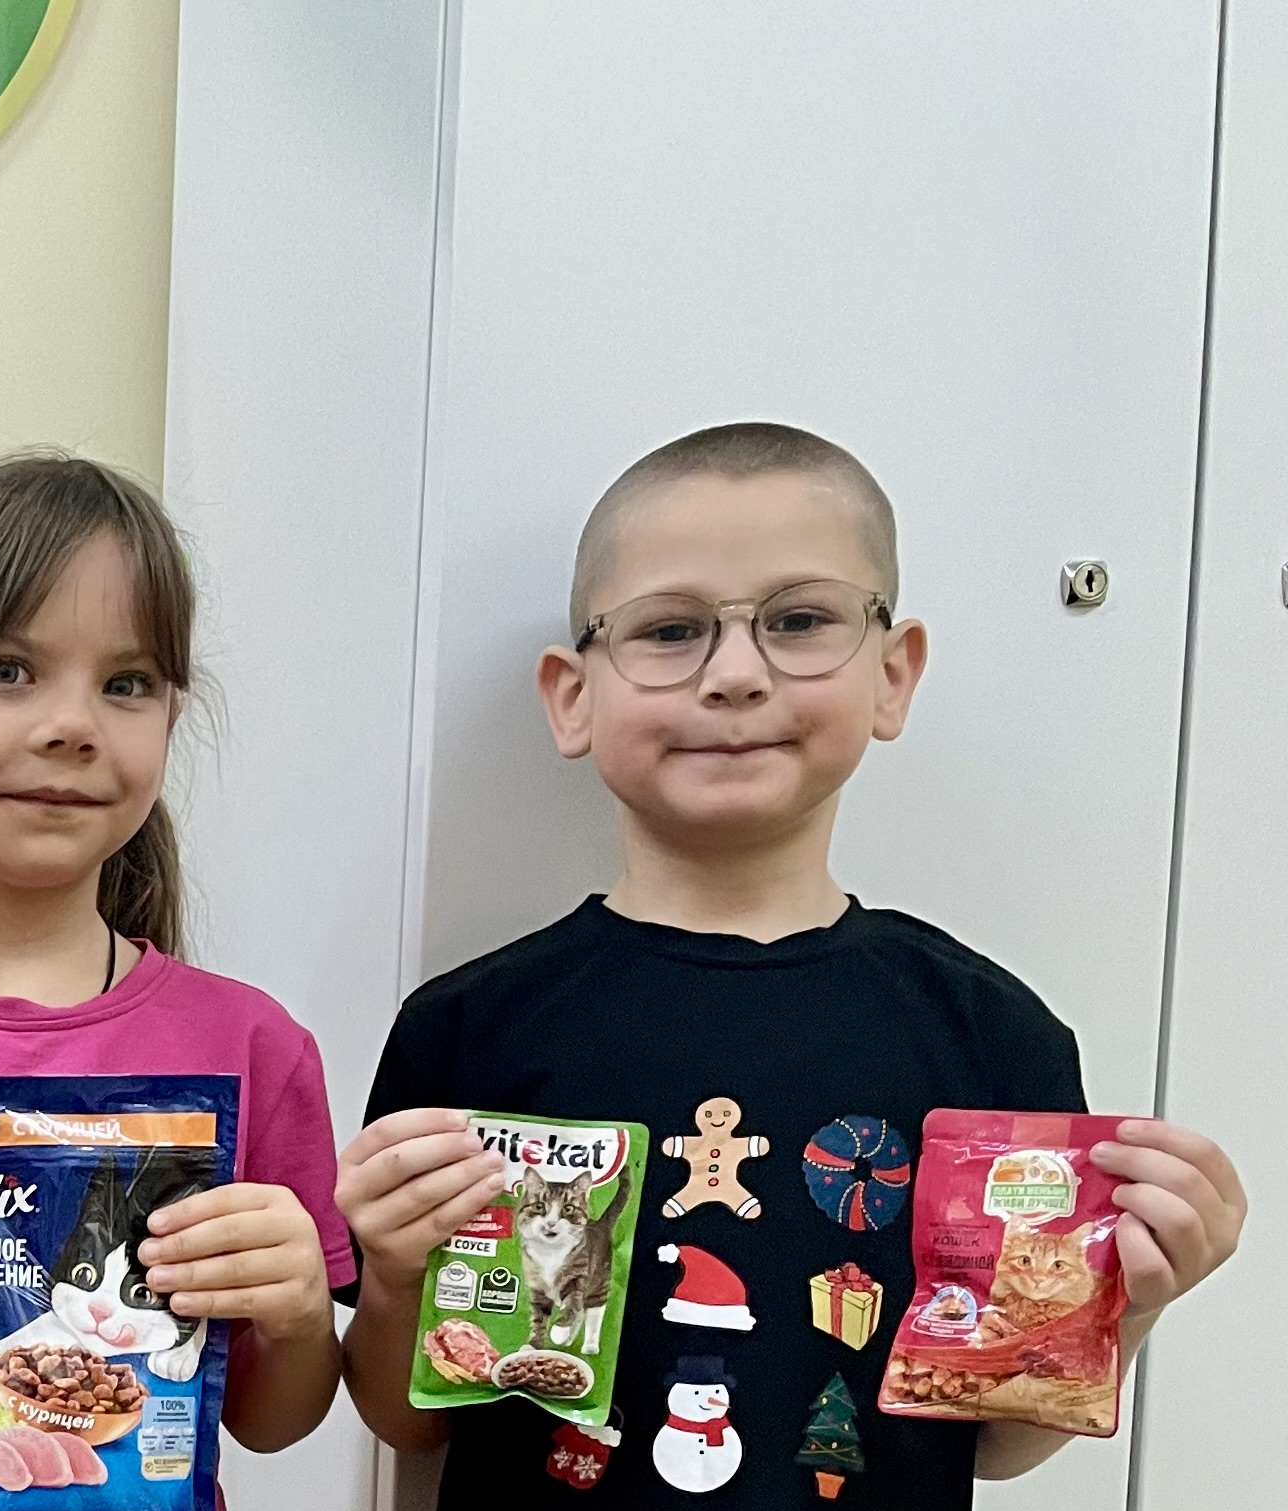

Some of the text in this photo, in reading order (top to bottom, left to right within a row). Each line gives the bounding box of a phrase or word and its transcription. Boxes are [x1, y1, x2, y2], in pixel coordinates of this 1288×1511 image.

[477, 1127, 606, 1170] kitekat
[454, 1238, 491, 1253] СОУСЕ
[160, 1399, 186, 1411] 100%
[18, 1402, 95, 1430] курицей
